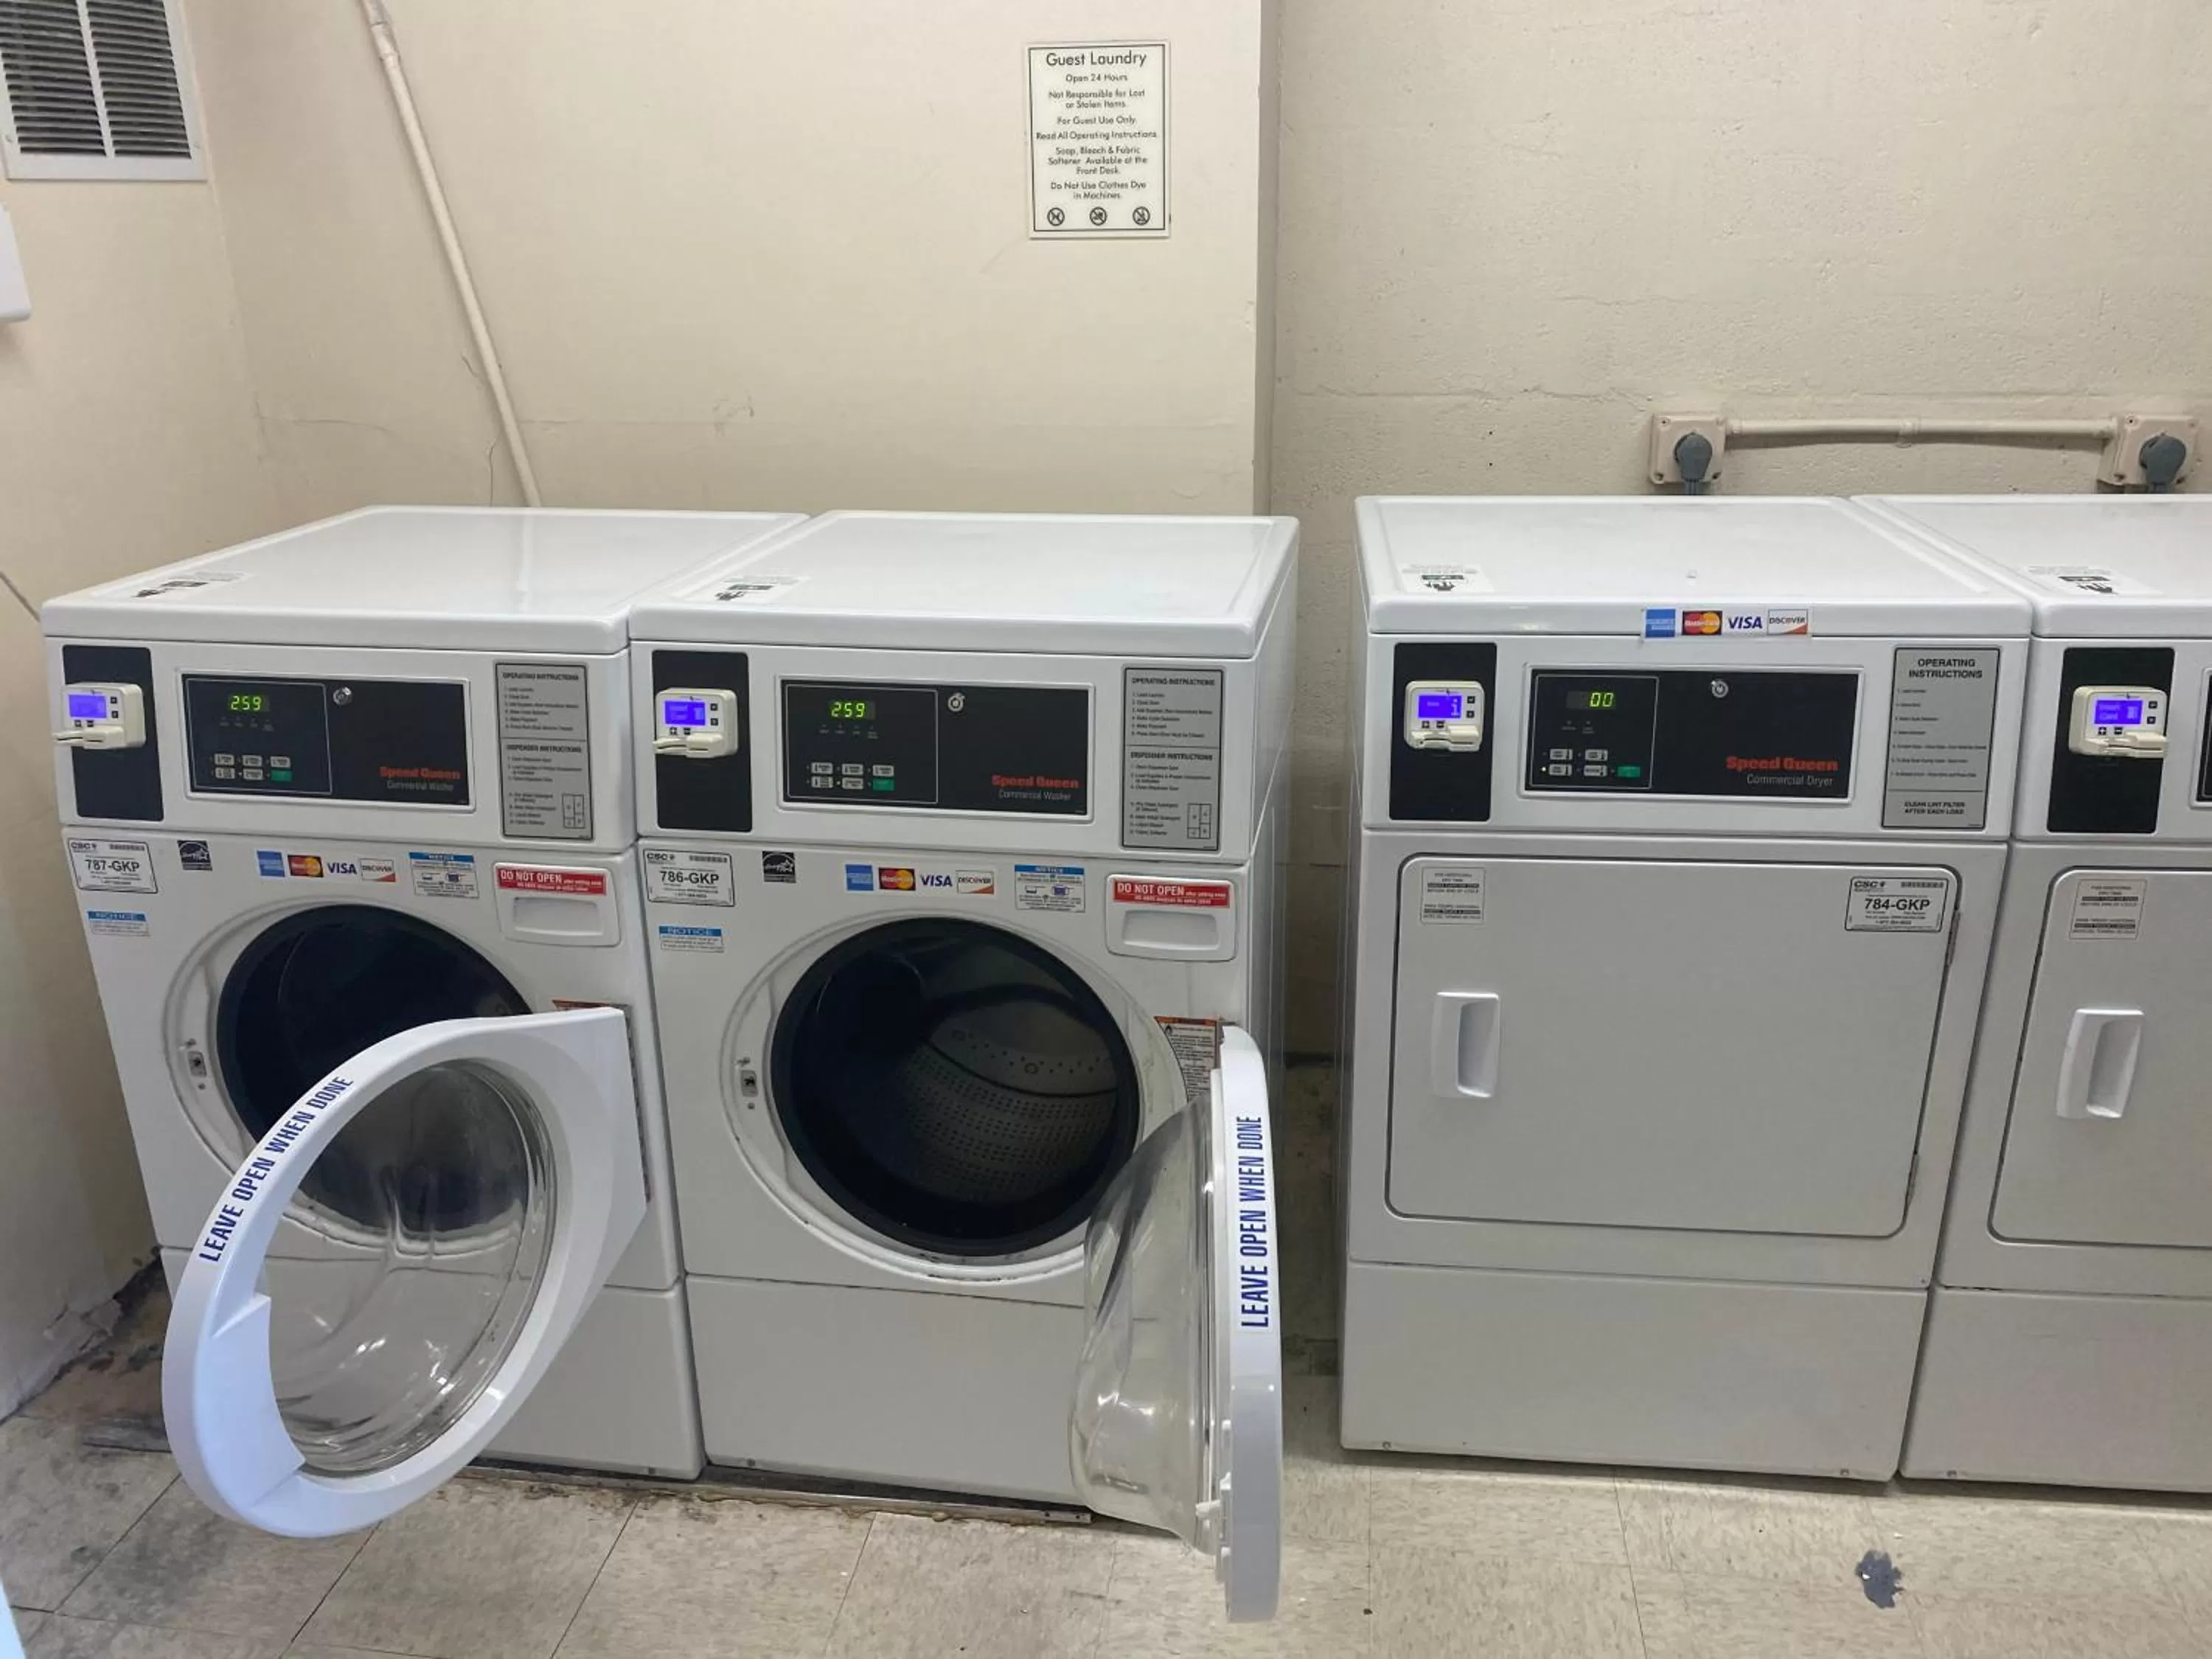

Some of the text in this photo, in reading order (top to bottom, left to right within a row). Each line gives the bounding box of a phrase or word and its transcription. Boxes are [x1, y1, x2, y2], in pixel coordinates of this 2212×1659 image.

[1046, 49, 1147, 68] Guest Laundry
[1065, 74, 1088, 83] Open
[1104, 74, 1127, 82] Hours
[1048, 88, 1145, 100] Not Responsible for Lost
[1077, 100, 1102, 108] Stolen
[1057, 116, 1071, 125] For
[1073, 116, 1096, 125] Guest
[1036, 132, 1056, 140] Read
[1057, 131, 1068, 139] All
[1069, 131, 1110, 140] Operating
[1080, 146, 1106, 154] Bleach
[1116, 146, 1141, 154] Fabric
[1085, 156, 1122, 164] Available
[1076, 167, 1098, 175] Front
[1064, 181, 1079, 189] Not
[1081, 181, 1096, 189] Use
[1098, 181, 1129, 189] Clothes
[1130, 181, 1147, 190] Dye
[1728, 616, 1763, 629] VISA
[1770, 615, 1806, 624] DISCOVER
[1918, 658, 1975, 667] OPERATING
[1909, 669, 1983, 678] INSTRUCTIONS
[231, 695, 262, 711] 259
[1590, 692, 1614, 707] 00
[831, 701, 866, 717] 259
[1726, 756, 1838, 771] Speed Queen
[379, 766, 461, 779] Speed Queen
[991, 775, 1079, 788] Speed Queen
[1747, 773, 1834, 787] Commercial Dryer
[999, 789, 1071, 800] Commercial Washer
[85, 859, 139, 872] 787-GKP
[327, 862, 358, 874] VISA
[501, 869, 513, 880] DO
[515, 870, 535, 882] NOT
[536, 872, 563, 883] OPEN
[659, 871, 720, 884] 786-GKP
[921, 874, 953, 887] VISA
[959, 876, 992, 884] DISCOVER
[1117, 882, 1132, 893] DO
[1134, 883, 1154, 894] NOT
[1157, 885, 1185, 896] OPEN
[1865, 897, 1930, 911] 784-GKP
[199, 1076, 355, 1262] LEAVE OPEN WHEN DONE
[1237, 1116, 1269, 1328] LEAVE OPEN WHEN DONE
